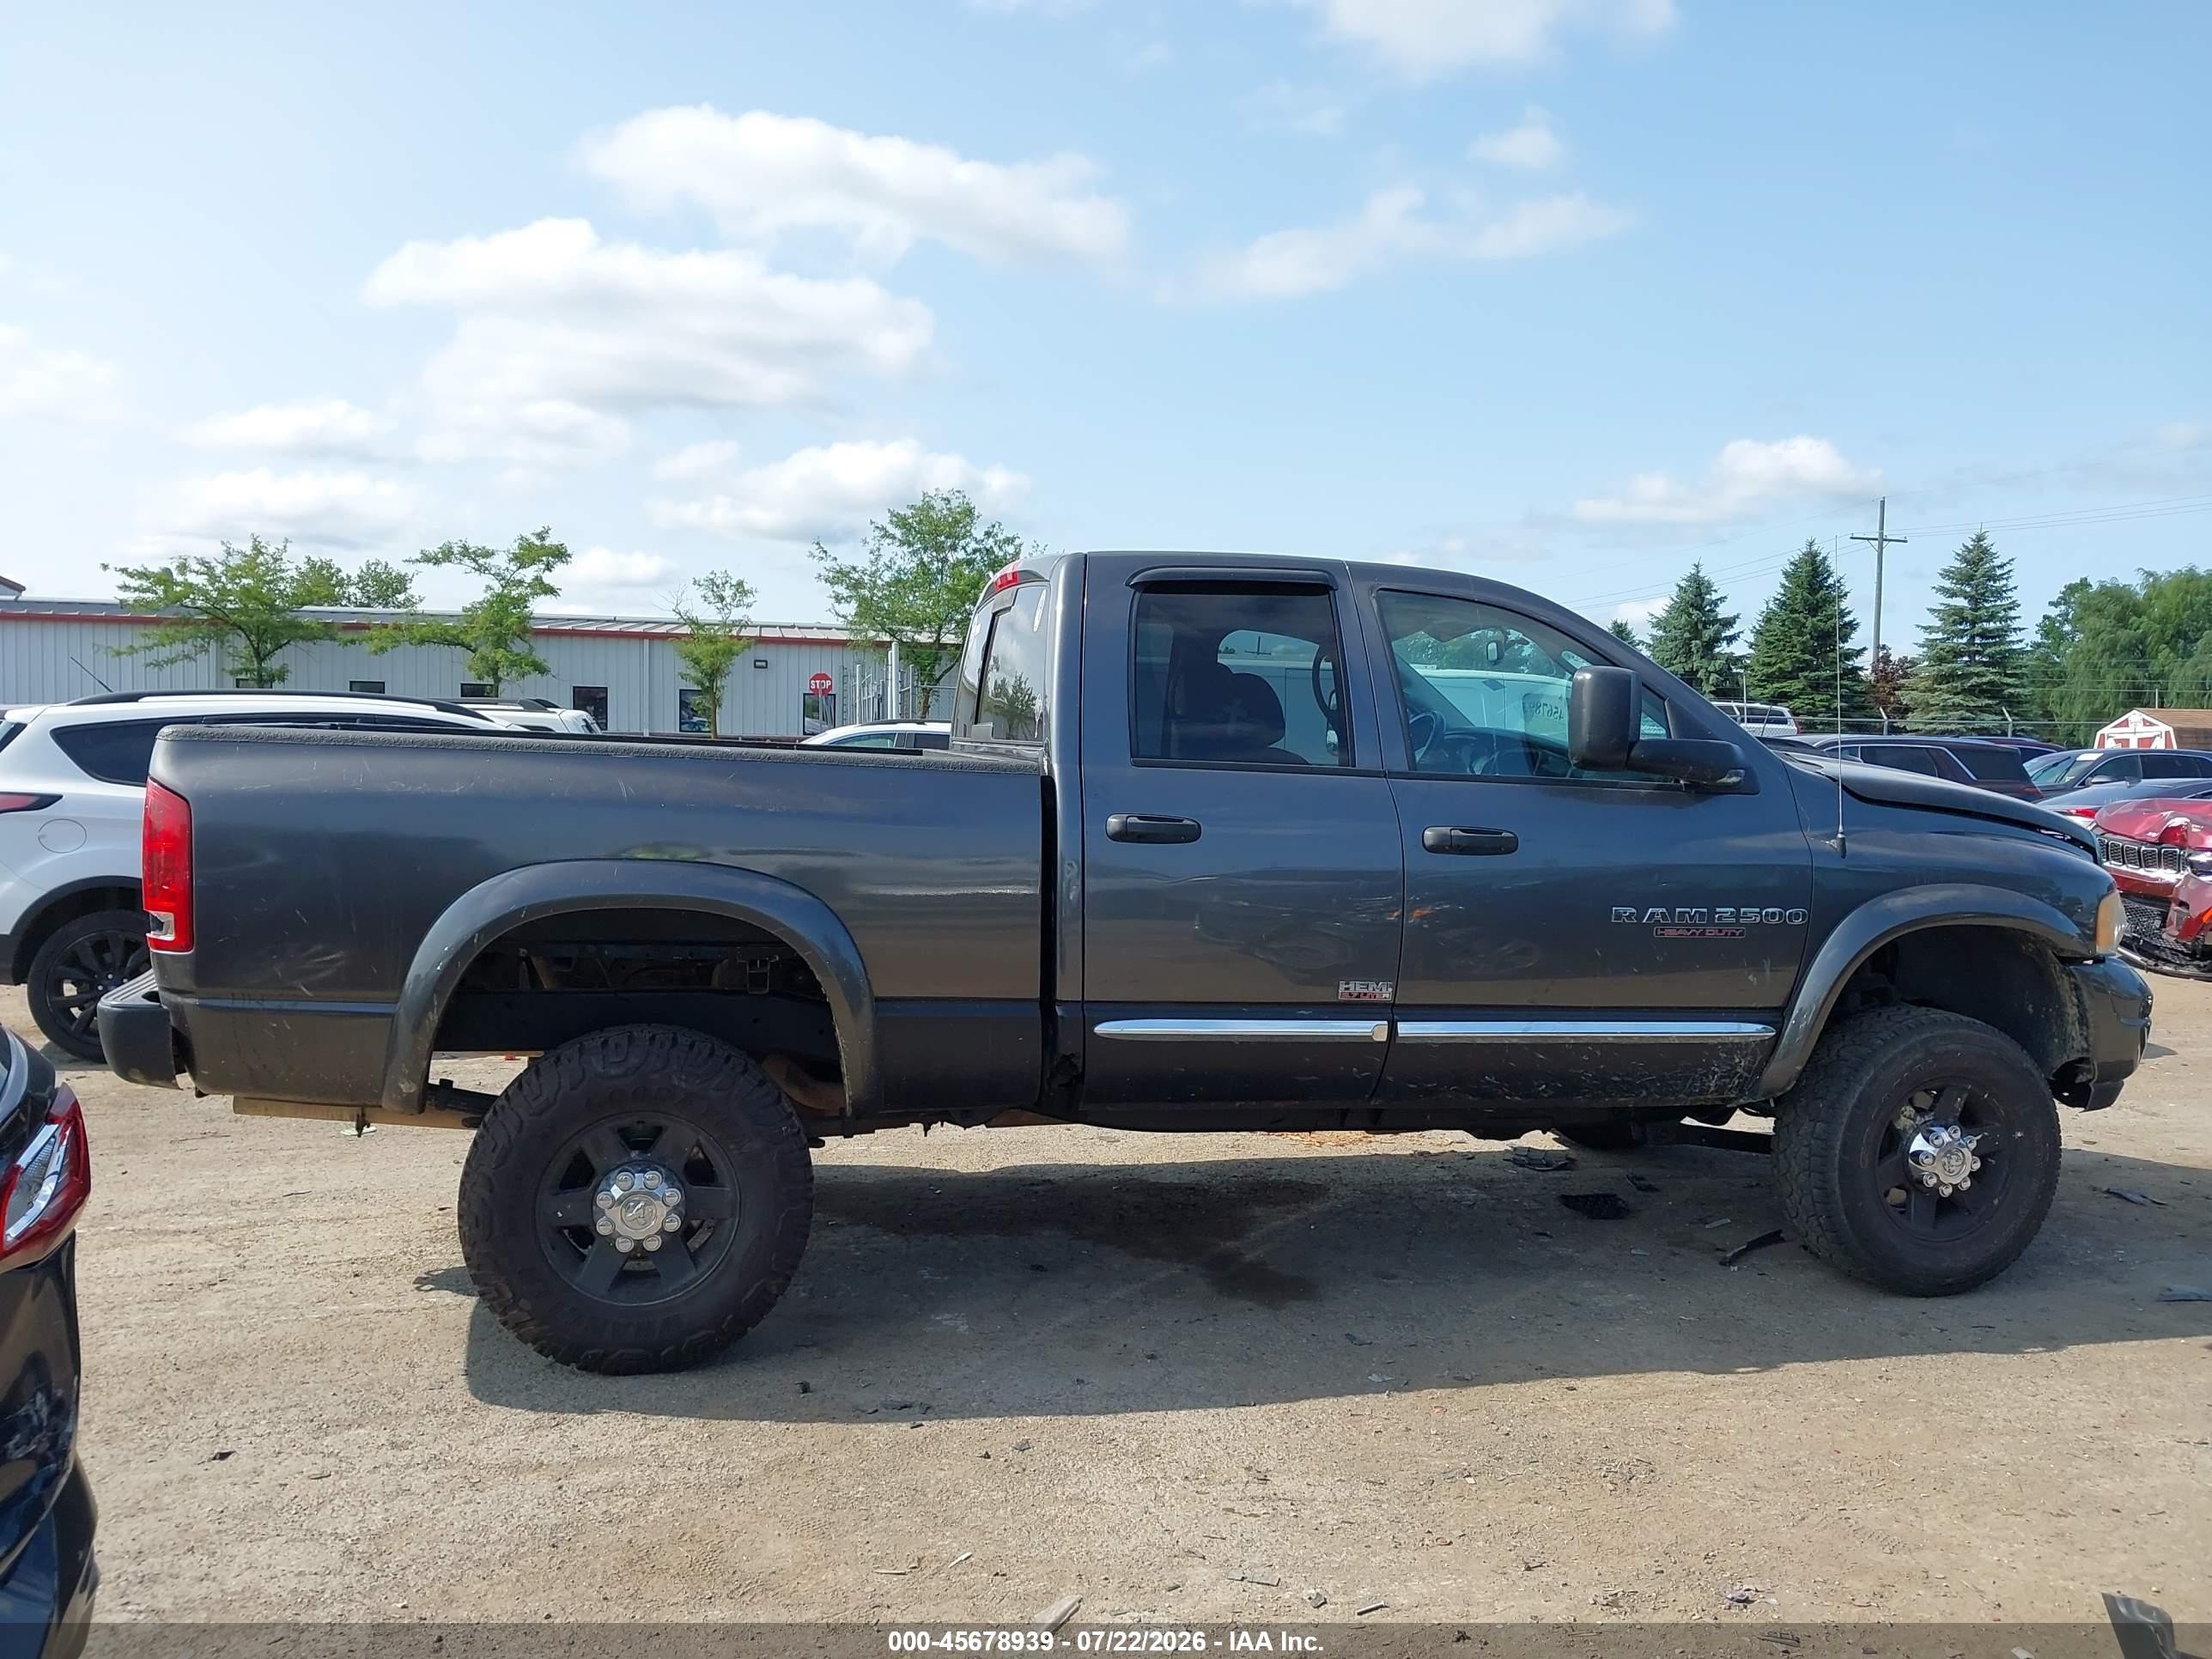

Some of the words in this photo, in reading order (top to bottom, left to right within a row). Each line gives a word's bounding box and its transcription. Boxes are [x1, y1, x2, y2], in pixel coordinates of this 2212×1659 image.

[810, 679, 832, 690] STOP
[1611, 907, 1708, 924] RAM
[1714, 907, 1808, 925] 2500
